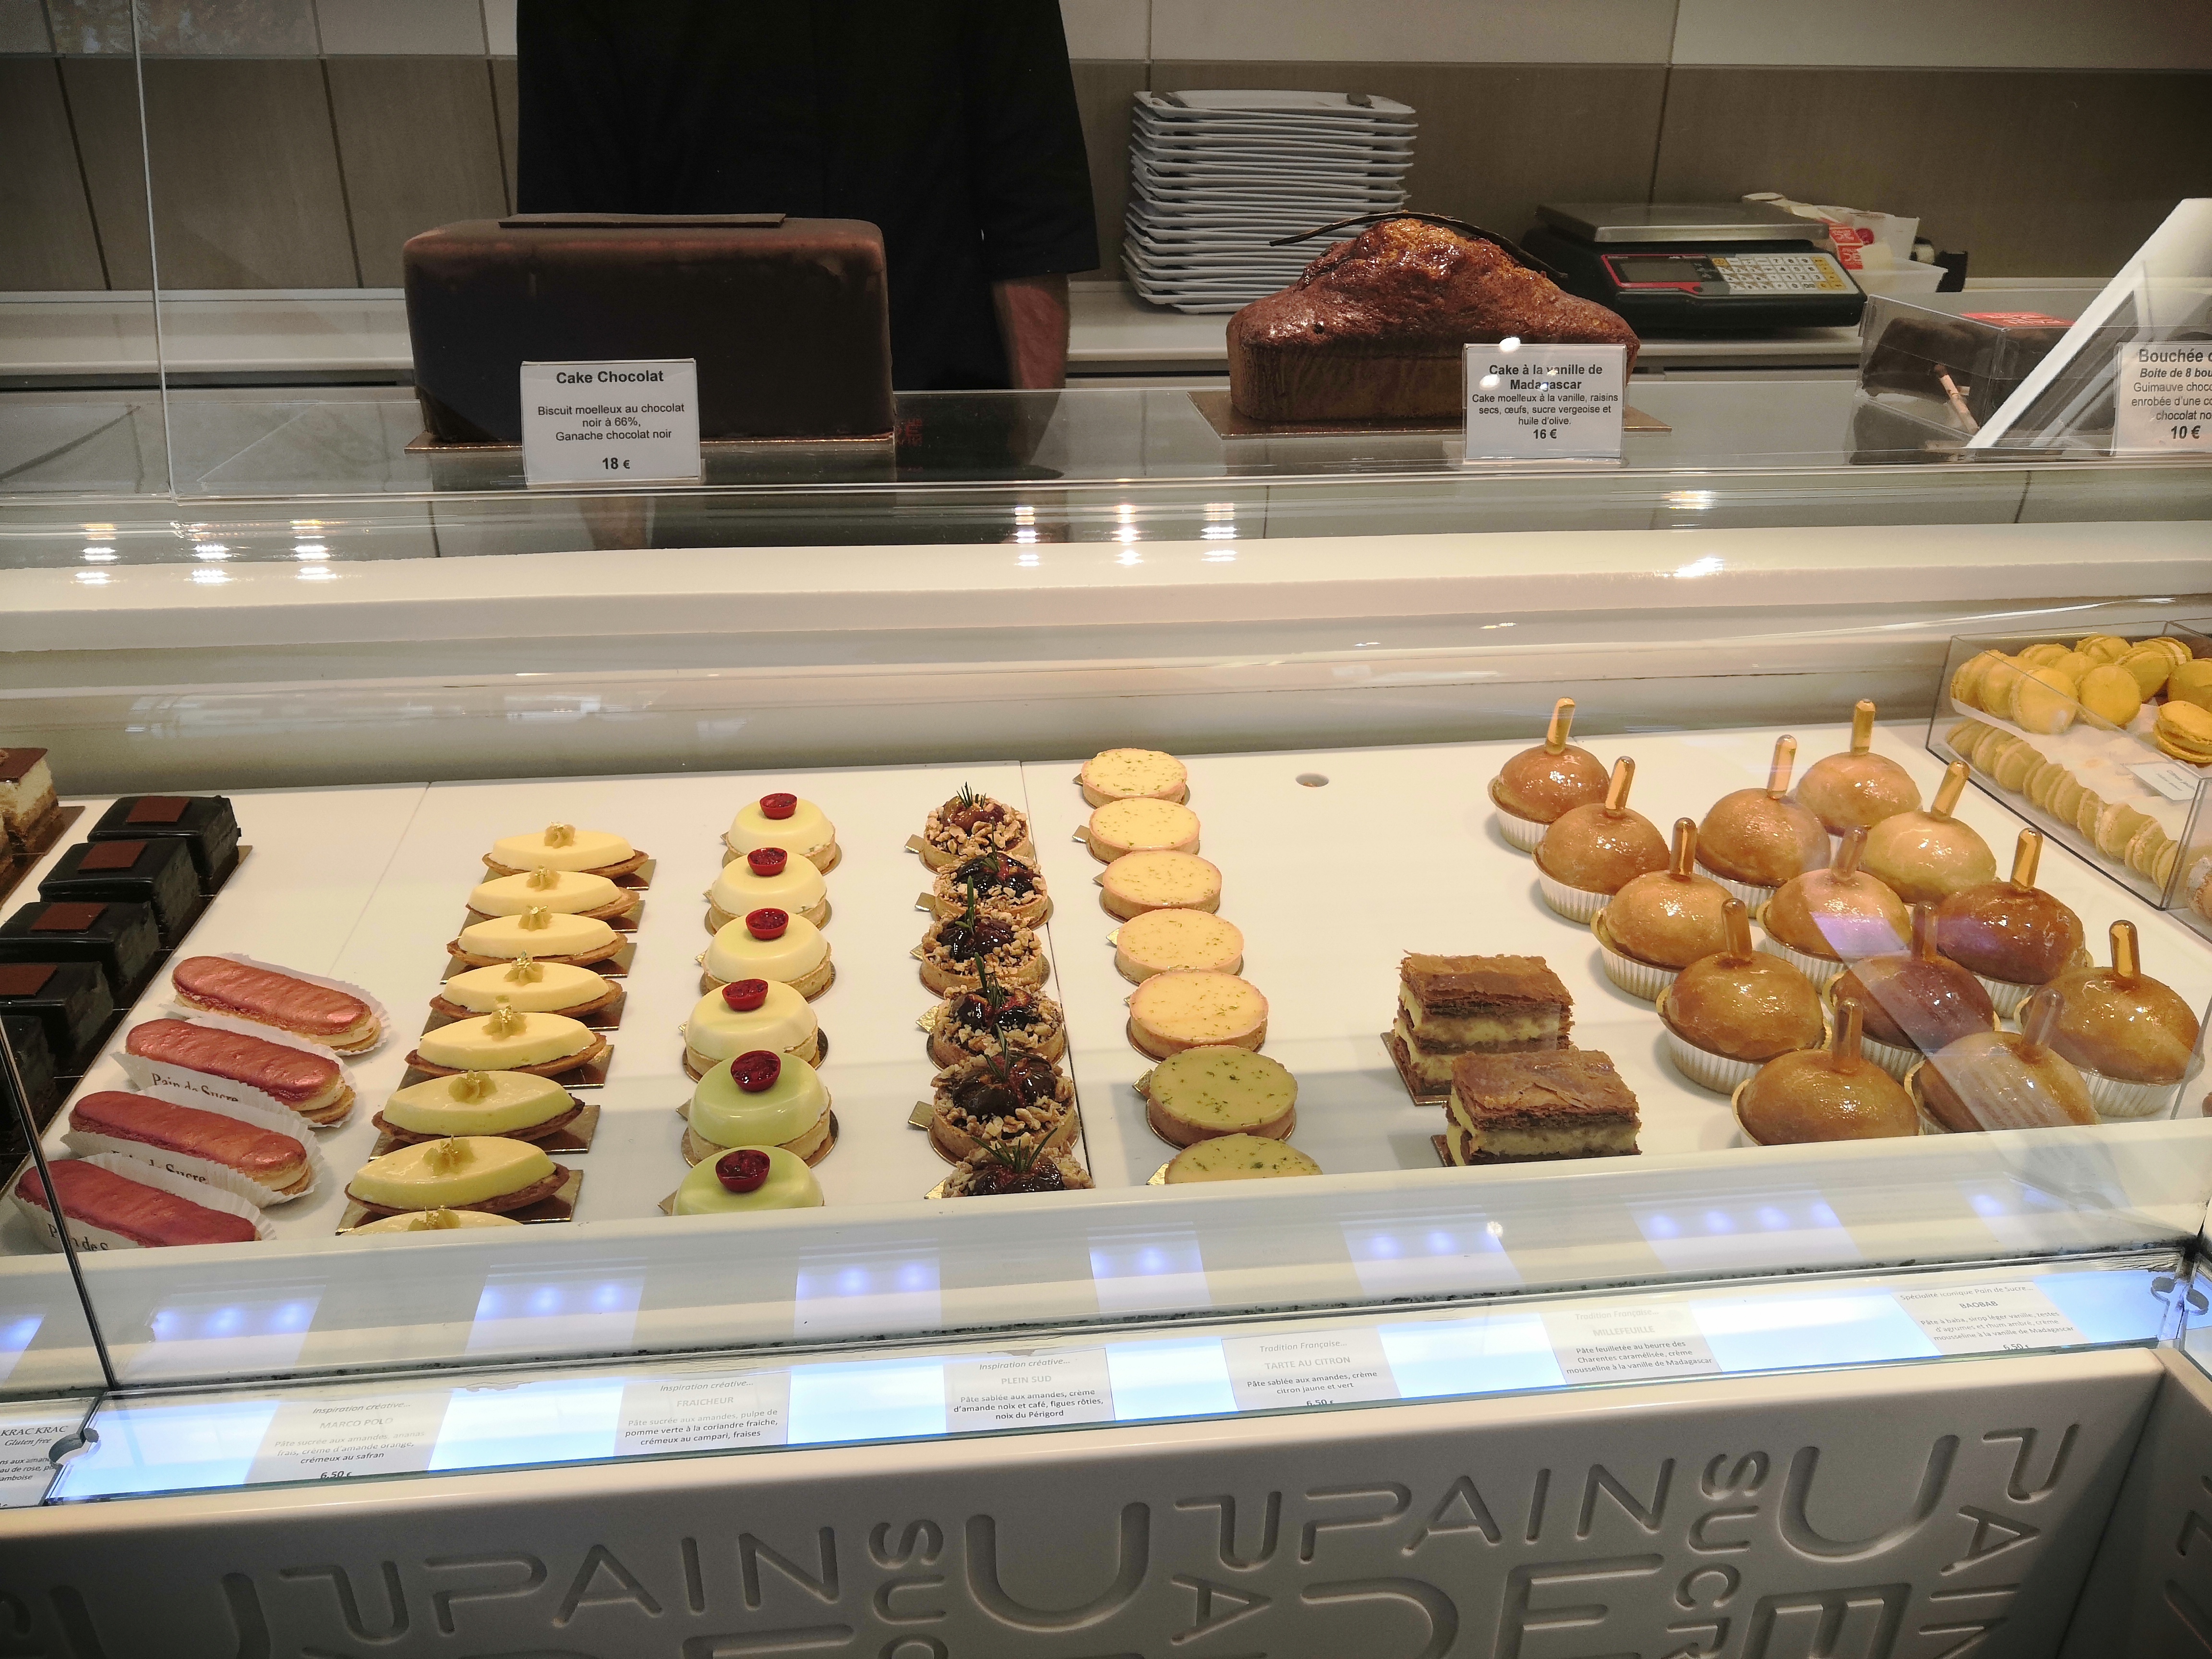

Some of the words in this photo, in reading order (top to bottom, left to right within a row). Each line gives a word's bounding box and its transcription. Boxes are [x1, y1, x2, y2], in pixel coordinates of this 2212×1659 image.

[2139, 349, 2203, 362] Bouchée
[1489, 365, 1519, 375] Cake
[1523, 364, 1529, 374] à
[1533, 364, 1543, 374] la
[1547, 364, 1585, 374] vanille
[1588, 364, 1602, 374] de
[2140, 368, 2167, 378] Boite
[2170, 368, 2182, 377] de
[2186, 368, 2191, 377] 8
[556, 372, 592, 384] Cake
[598, 370, 664, 383] Chocolat
[2134, 383, 2183, 392] Guimauve
[1558, 393, 1587, 403] vanille,
[1590, 393, 1618, 401] raisins
[2132, 397, 2171, 406] enrobée
[2175, 397, 2201, 406] d'une
[538, 406, 572, 415] Biscuit
[576, 405, 622, 414] moelleux
[641, 403, 685, 412] chocolat
[1559, 406, 1600, 415] vergeoise
[2156, 410, 2197, 420] chocolat
[582, 418, 601, 427] noir
[605, 417, 612, 426] à
[614, 417, 640, 427] 66%,
[556, 432, 603, 441] Ganache
[606, 430, 649, 439] chocolat
[653, 430, 672, 438] noir
[1533, 429, 1546, 439] 16
[1550, 429, 1557, 439] €
[2171, 425, 2187, 439] 10
[2191, 425, 2201, 439] €
[602, 457, 618, 469] 18
[624, 459, 630, 469] €
[1900, 1293, 1938, 1301] Spécialité
[1960, 1300, 1998, 1309] BAOBAB
[1575, 1311, 1611, 1320] Tradition
[1921, 1318, 1938, 1326] Pâte
[1946, 1316, 1967, 1325] baba,
[1968, 1315, 1987, 1323] sirop
[1987, 1313, 2007, 1322] léger
[2008, 1311, 2036, 1319] vanille,
[1593, 1325, 1655, 1336] MILLEFEUILLE
[1934, 1332, 1976, 1341] mousseline
[1992, 1328, 2017, 1337] vanille
[2029, 1325, 2074, 1334] Madagascar
[1260, 1343, 1298, 1352] Tradition
[1595, 1344, 1632, 1353] feuilletée
[1577, 1355, 1617, 1363] Charentes
[1619, 1351, 1667, 1360] caramélisée,
[980, 1361, 1026, 1370] Inspiration
[1264, 1361, 1296, 1370] TARTE
[1298, 1359, 1311, 1367] AU
[1315, 1356, 1350, 1365] CITRON
[1567, 1365, 1611, 1374] mousseline
[1628, 1360, 1653, 1369] vanille
[1666, 1357, 1712, 1366] Madagascar
[1312, 1373, 1350, 1382] amandes,
[661, 1383, 708, 1393] Inspiration
[1303, 1384, 1325, 1393] jaune
[1027, 1391, 1067, 1399] amandes,
[677, 1396, 733, 1407] FRAICHEUR
[1050, 1399, 1075, 1408] figues
[1078, 1397, 1103, 1406] rôties,
[313, 1405, 363, 1415] Inspiration
[1029, 1410, 1064, 1419] Périgord
[697, 1413, 738, 1422] amandes,
[741, 1410, 764, 1419] pulpe
[320, 1421, 361, 1430] MARCO
[364, 1418, 393, 1426] POLO
[625, 1429, 659, 1438] pomme
[703, 1421, 744, 1431] coriandre
[746, 1419, 778, 1427] fraiche,
[1, 1428, 34, 1436] KRAC
[35, 1425, 68, 1434] KRAC
[32, 1438, 52, 1446] free
[348, 1434, 391, 1443] amandes,
[640, 1437, 678, 1446] crémeux
[693, 1433, 730, 1442] campari,
[733, 1430, 760, 1438] fraises
[380, 1442, 414, 1450] orange,
[301, 1456, 340, 1465] crémeux
[356, 1452, 384, 1460] safran
[1299, 1457, 1676, 1565] PAIN
[425, 1525, 840, 1637] PAIN
